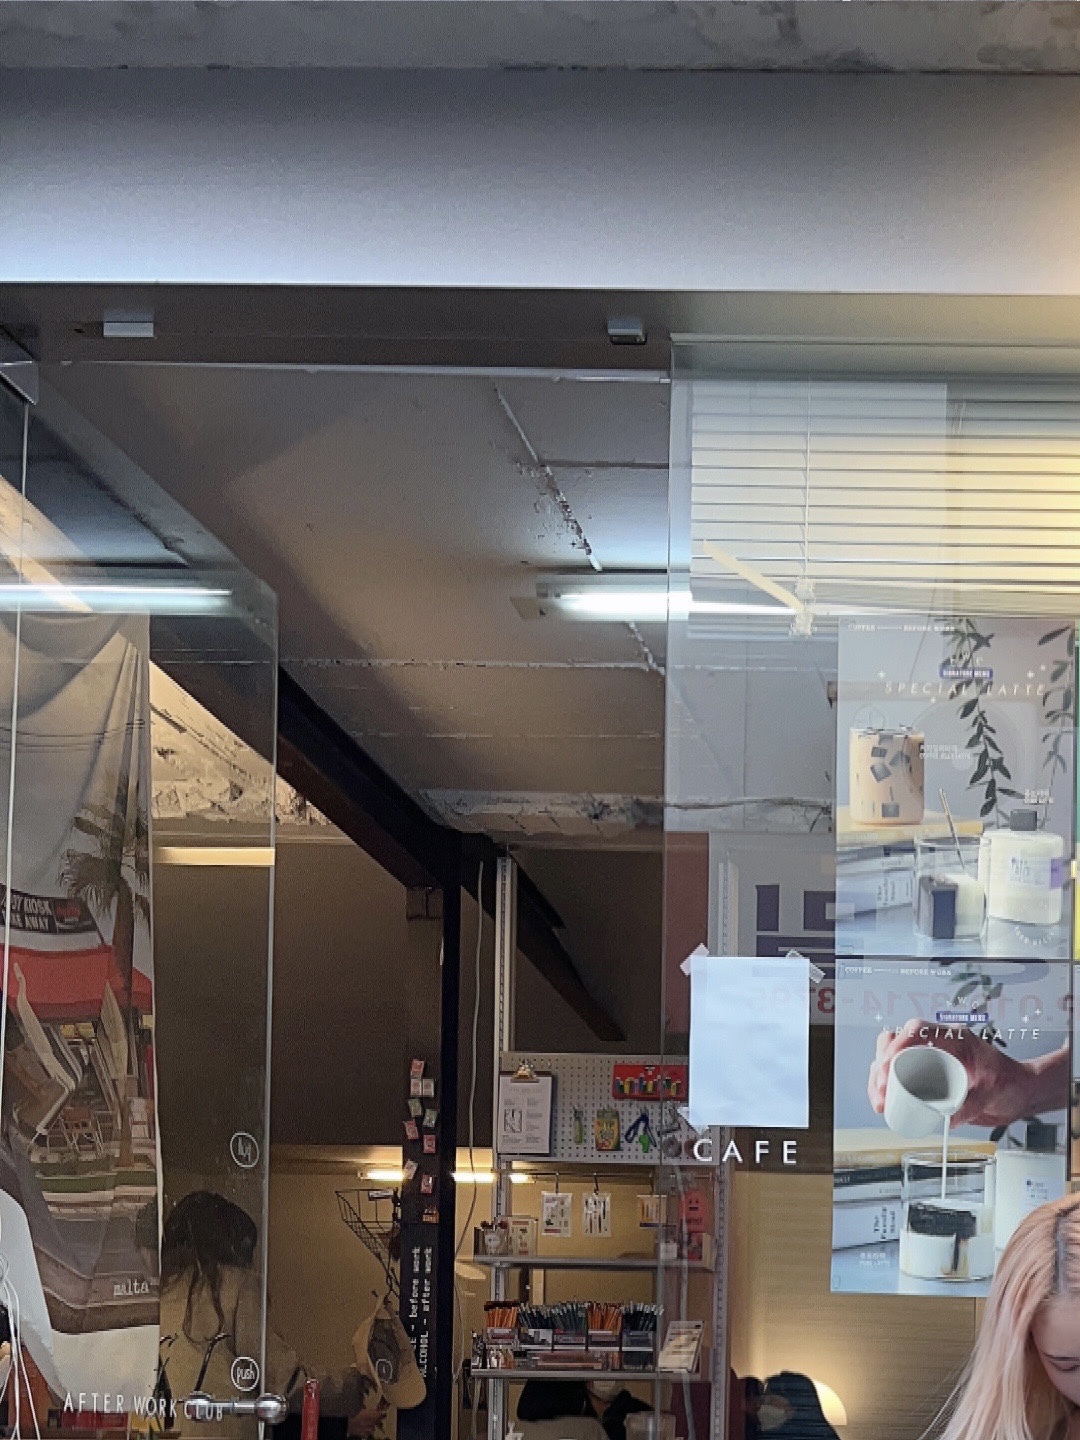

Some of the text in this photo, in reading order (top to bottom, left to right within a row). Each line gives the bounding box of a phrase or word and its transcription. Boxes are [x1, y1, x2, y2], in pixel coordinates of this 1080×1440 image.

[884, 681, 1045, 696] SPECIAL LATTE
[981, 1028, 1041, 1040] LATTE
[693, 1138, 798, 1164] CAFE
[423, 1246, 432, 1274] work
[409, 1246, 421, 1318] before work
[421, 1278, 431, 1312] after
[236, 1364, 255, 1380] push
[63, 1391, 224, 1422] AFTER WORK CLUB
